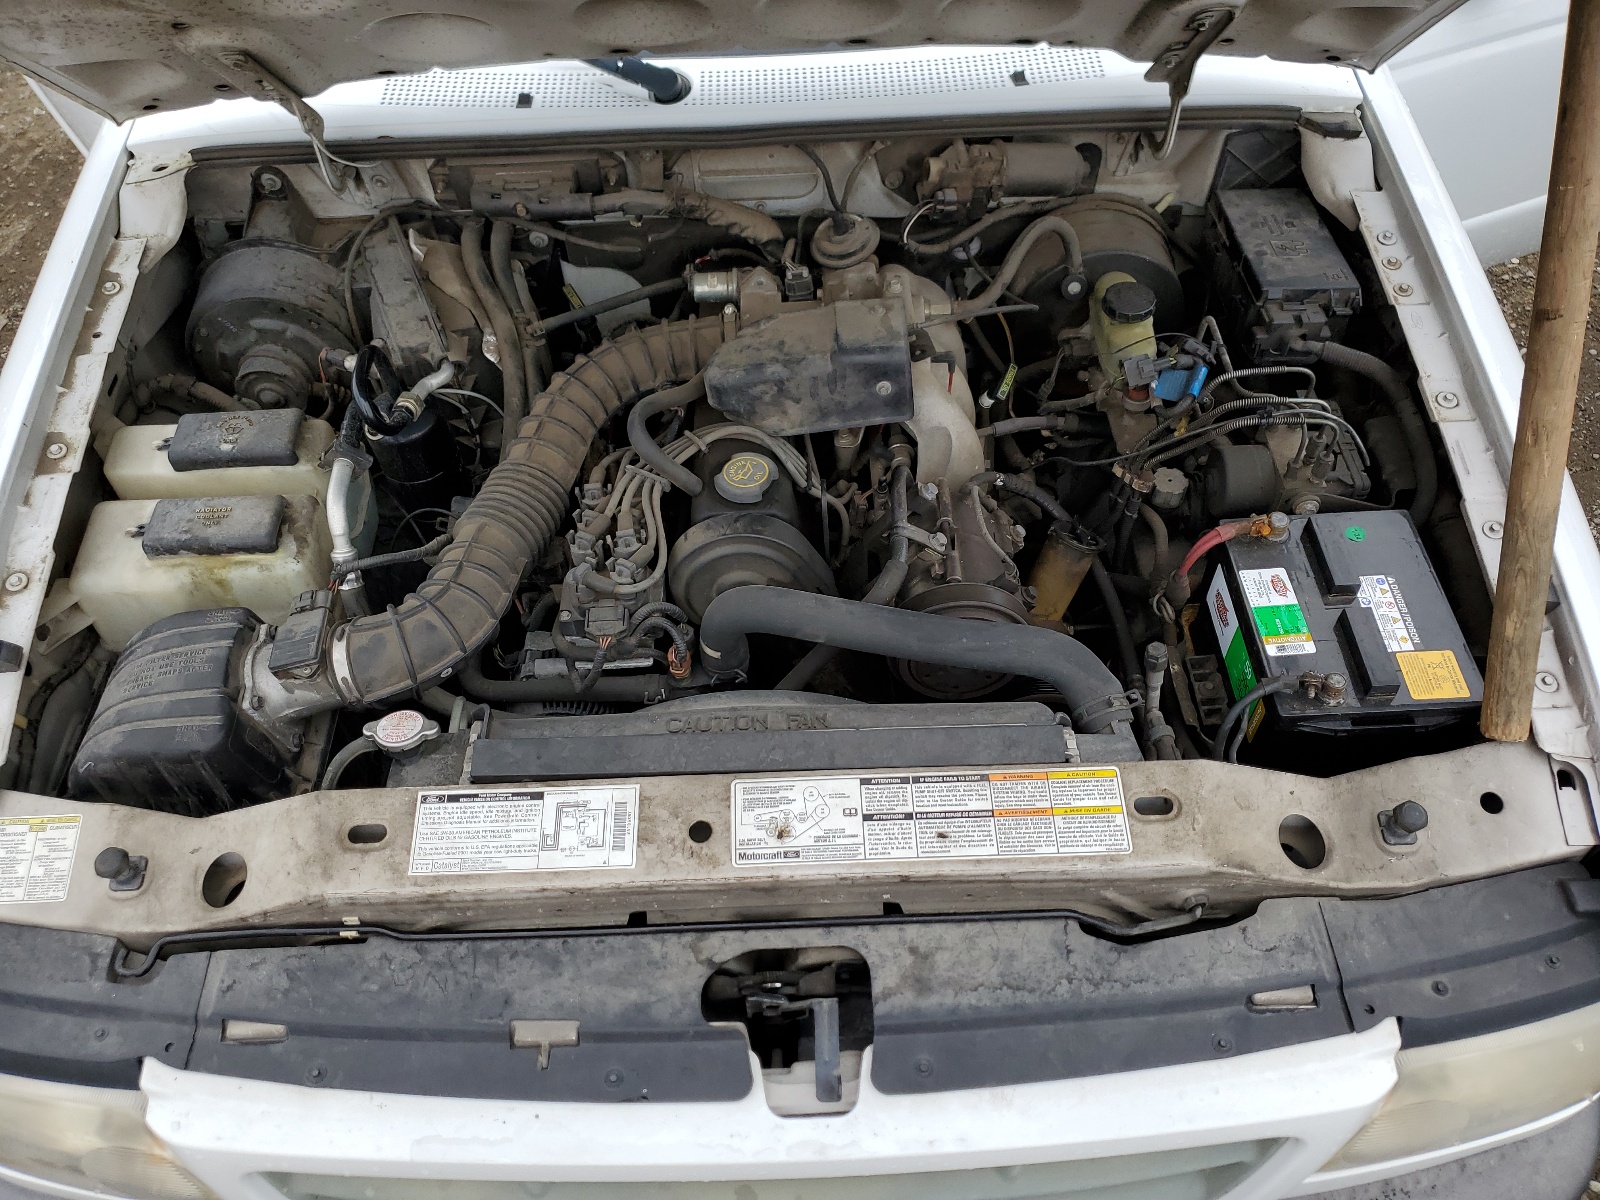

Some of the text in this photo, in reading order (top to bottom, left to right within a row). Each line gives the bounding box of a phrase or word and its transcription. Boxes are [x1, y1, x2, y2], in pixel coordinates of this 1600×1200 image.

[753, 471, 764, 481] OIL
[195, 506, 233, 514] RADIATOR
[1391, 584, 1408, 614] DANGER
[1403, 617, 1421, 644] POISON
[667, 713, 829, 734] CAUTION FAN
[738, 850, 782, 861] Motorcraft
[433, 861, 460, 871] Catalyst
